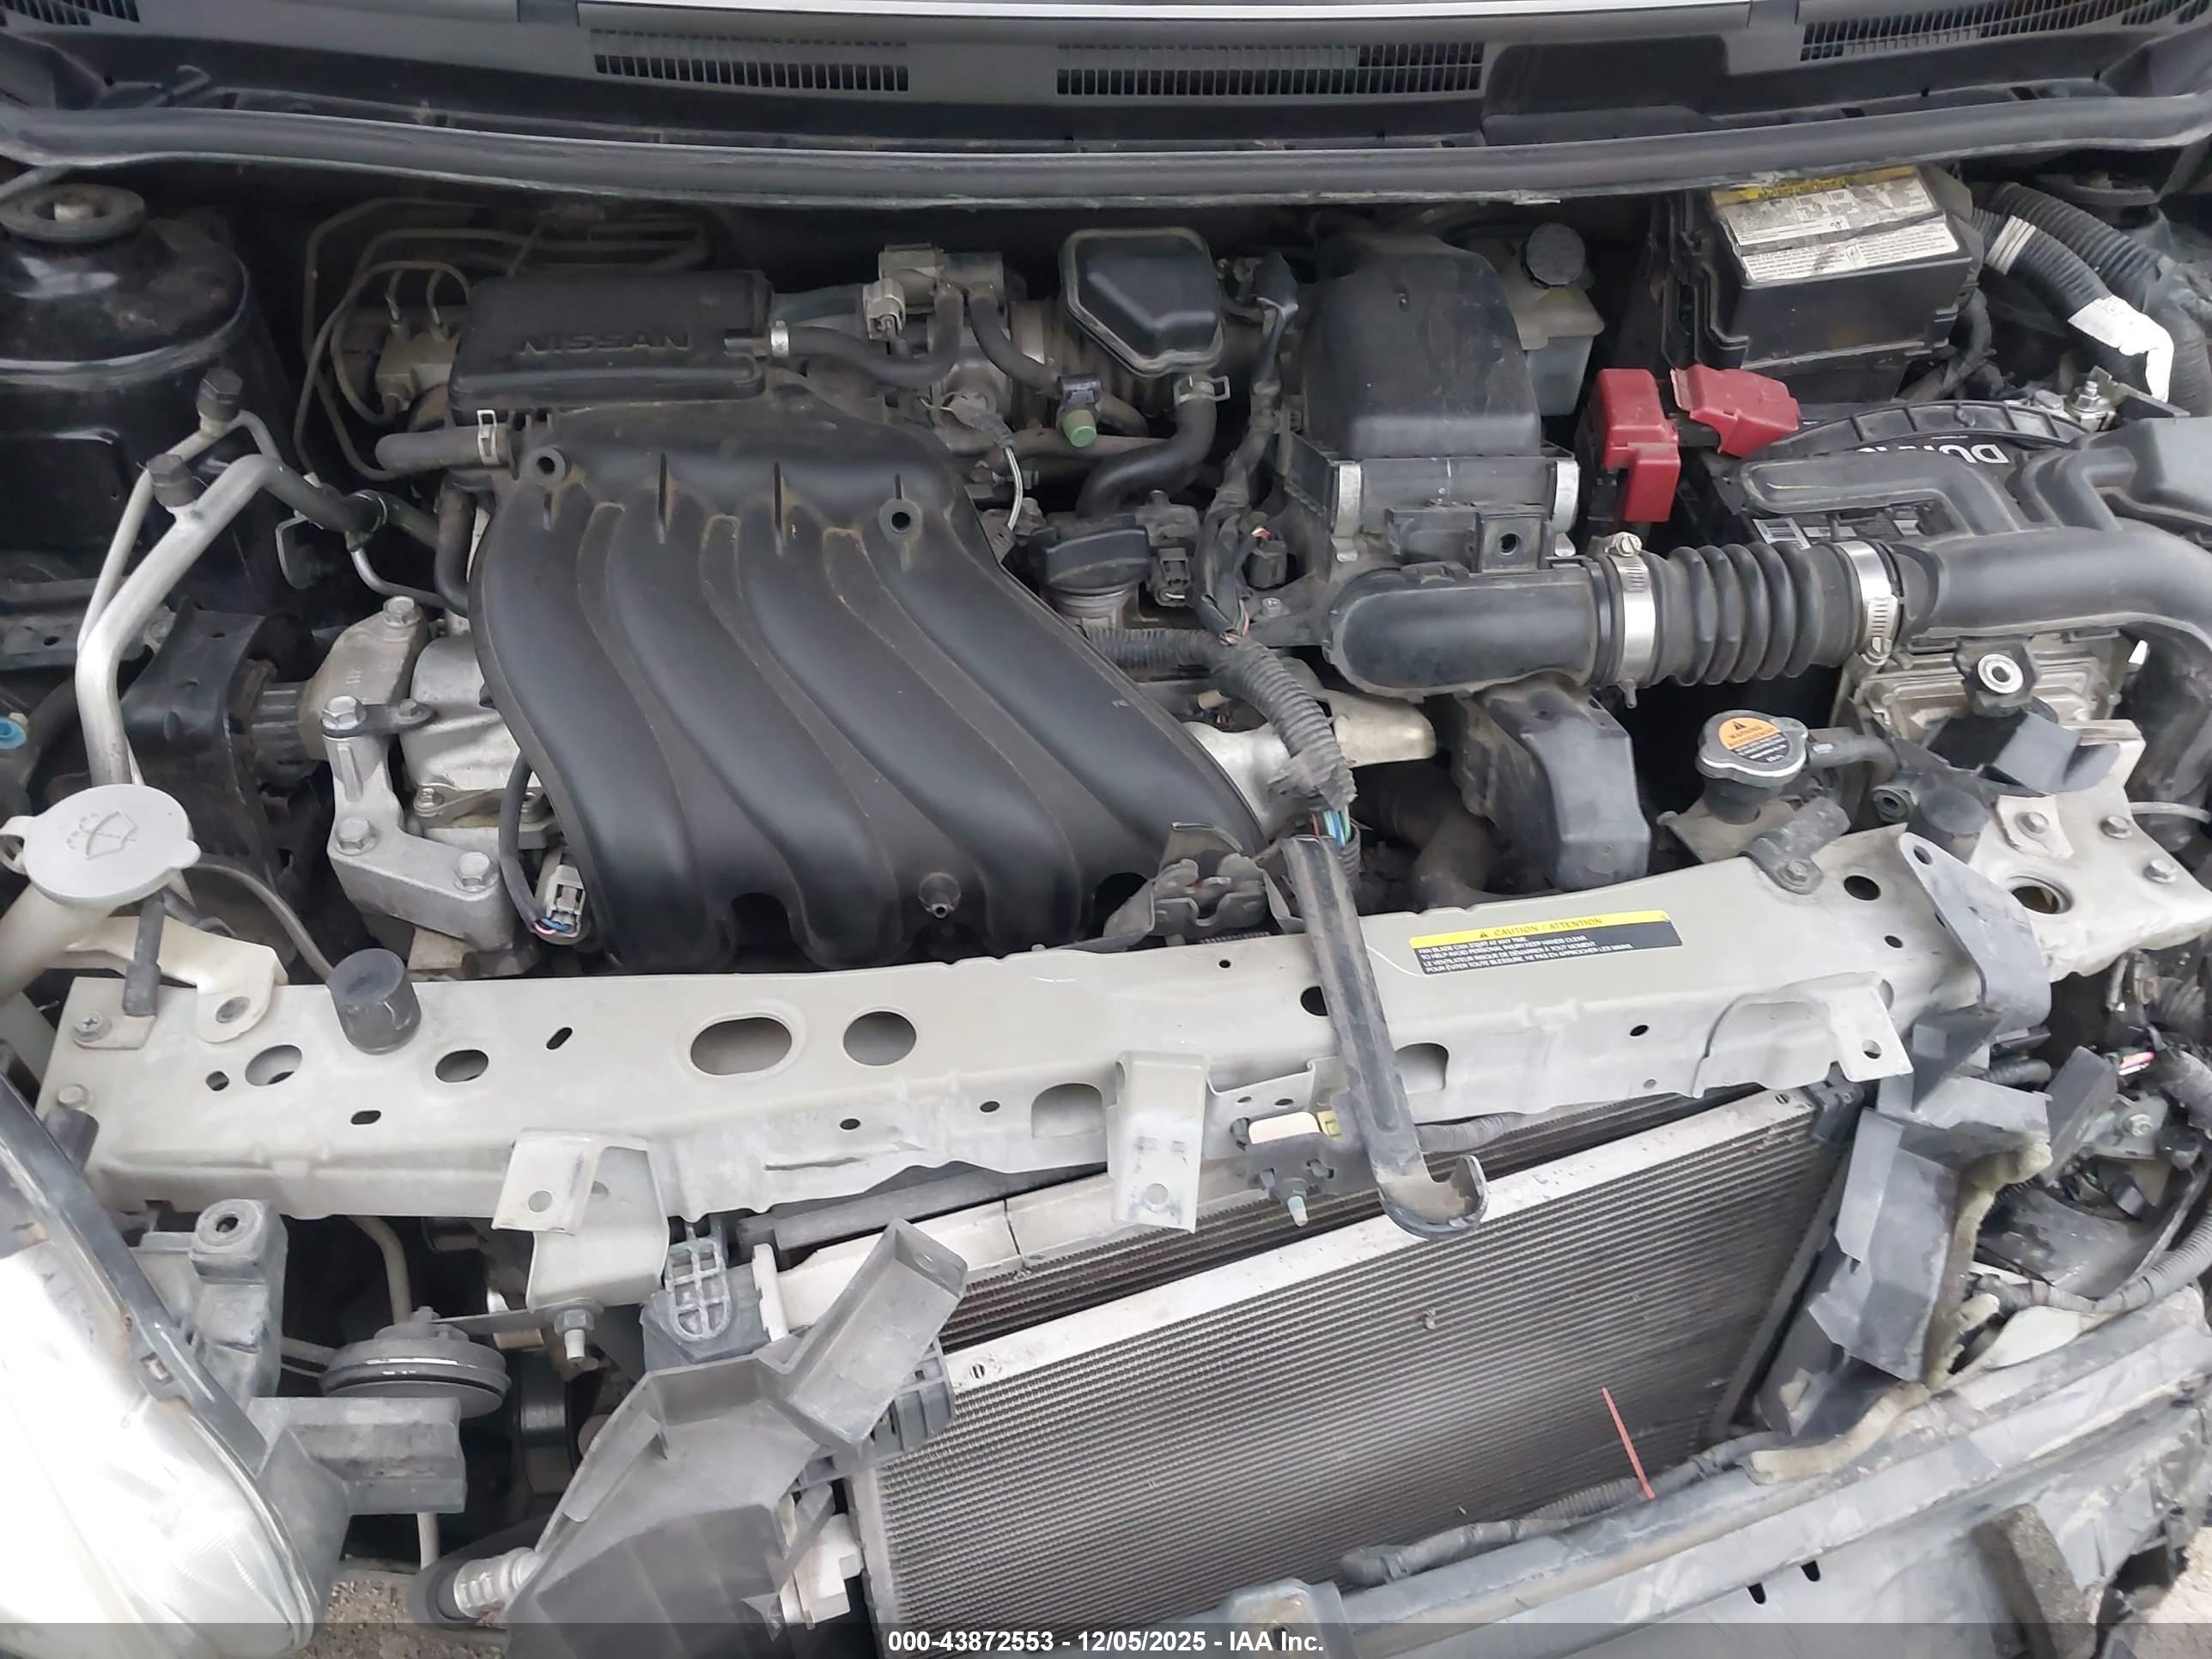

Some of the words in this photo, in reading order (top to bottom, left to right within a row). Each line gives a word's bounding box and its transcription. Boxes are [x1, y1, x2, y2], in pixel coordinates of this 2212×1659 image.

[518, 333, 690, 356] NISSAN
[1494, 925, 1539, 937] CAUTION
[1549, 918, 1603, 930] ATTENTION
